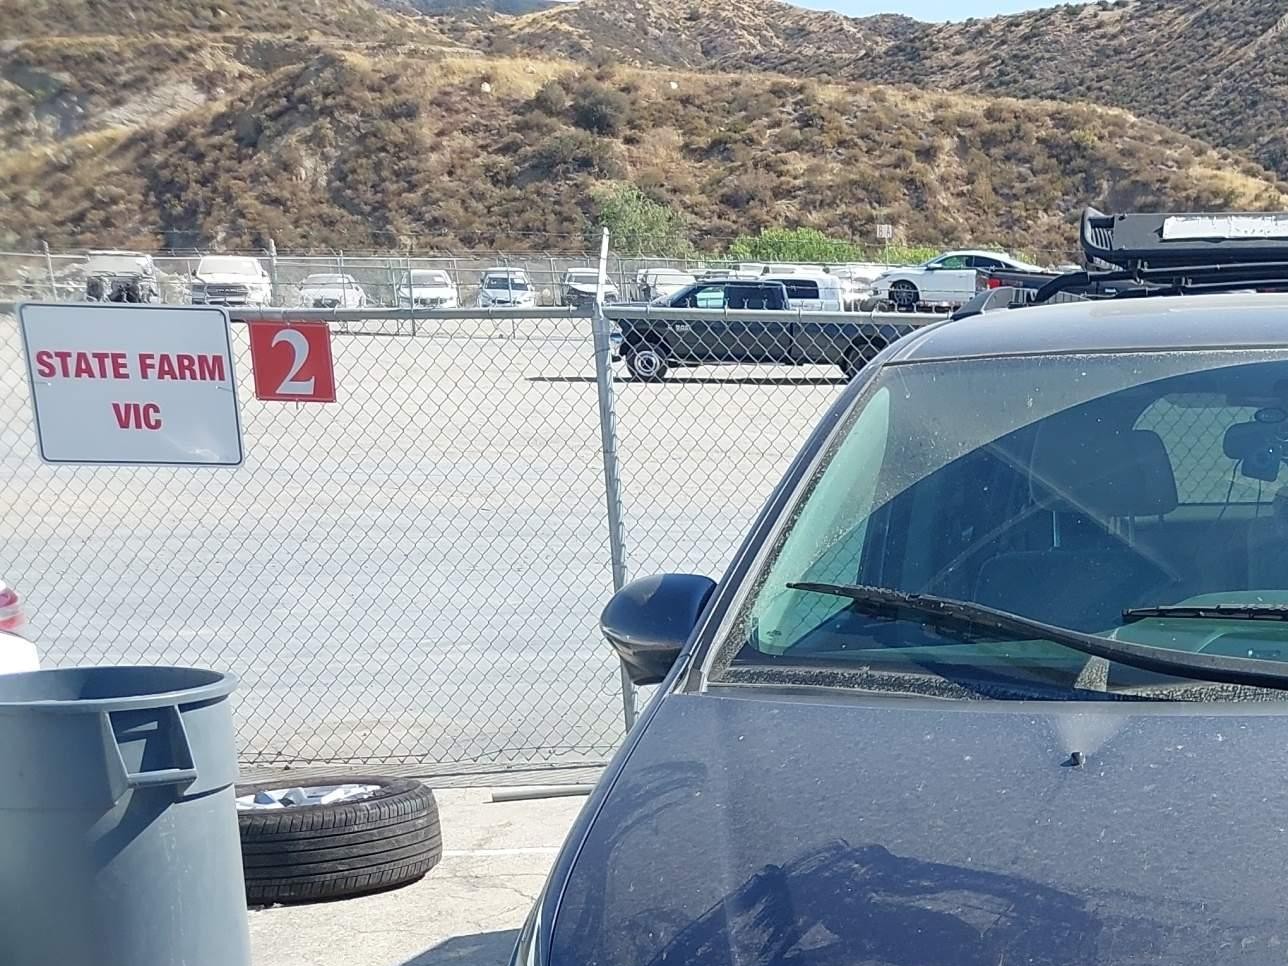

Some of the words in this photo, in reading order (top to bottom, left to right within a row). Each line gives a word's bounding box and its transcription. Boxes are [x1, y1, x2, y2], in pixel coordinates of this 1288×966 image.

[36, 351, 130, 380] STATE
[138, 352, 226, 382] FARM
[271, 329, 315, 395] 2
[112, 402, 163, 431] VIC
